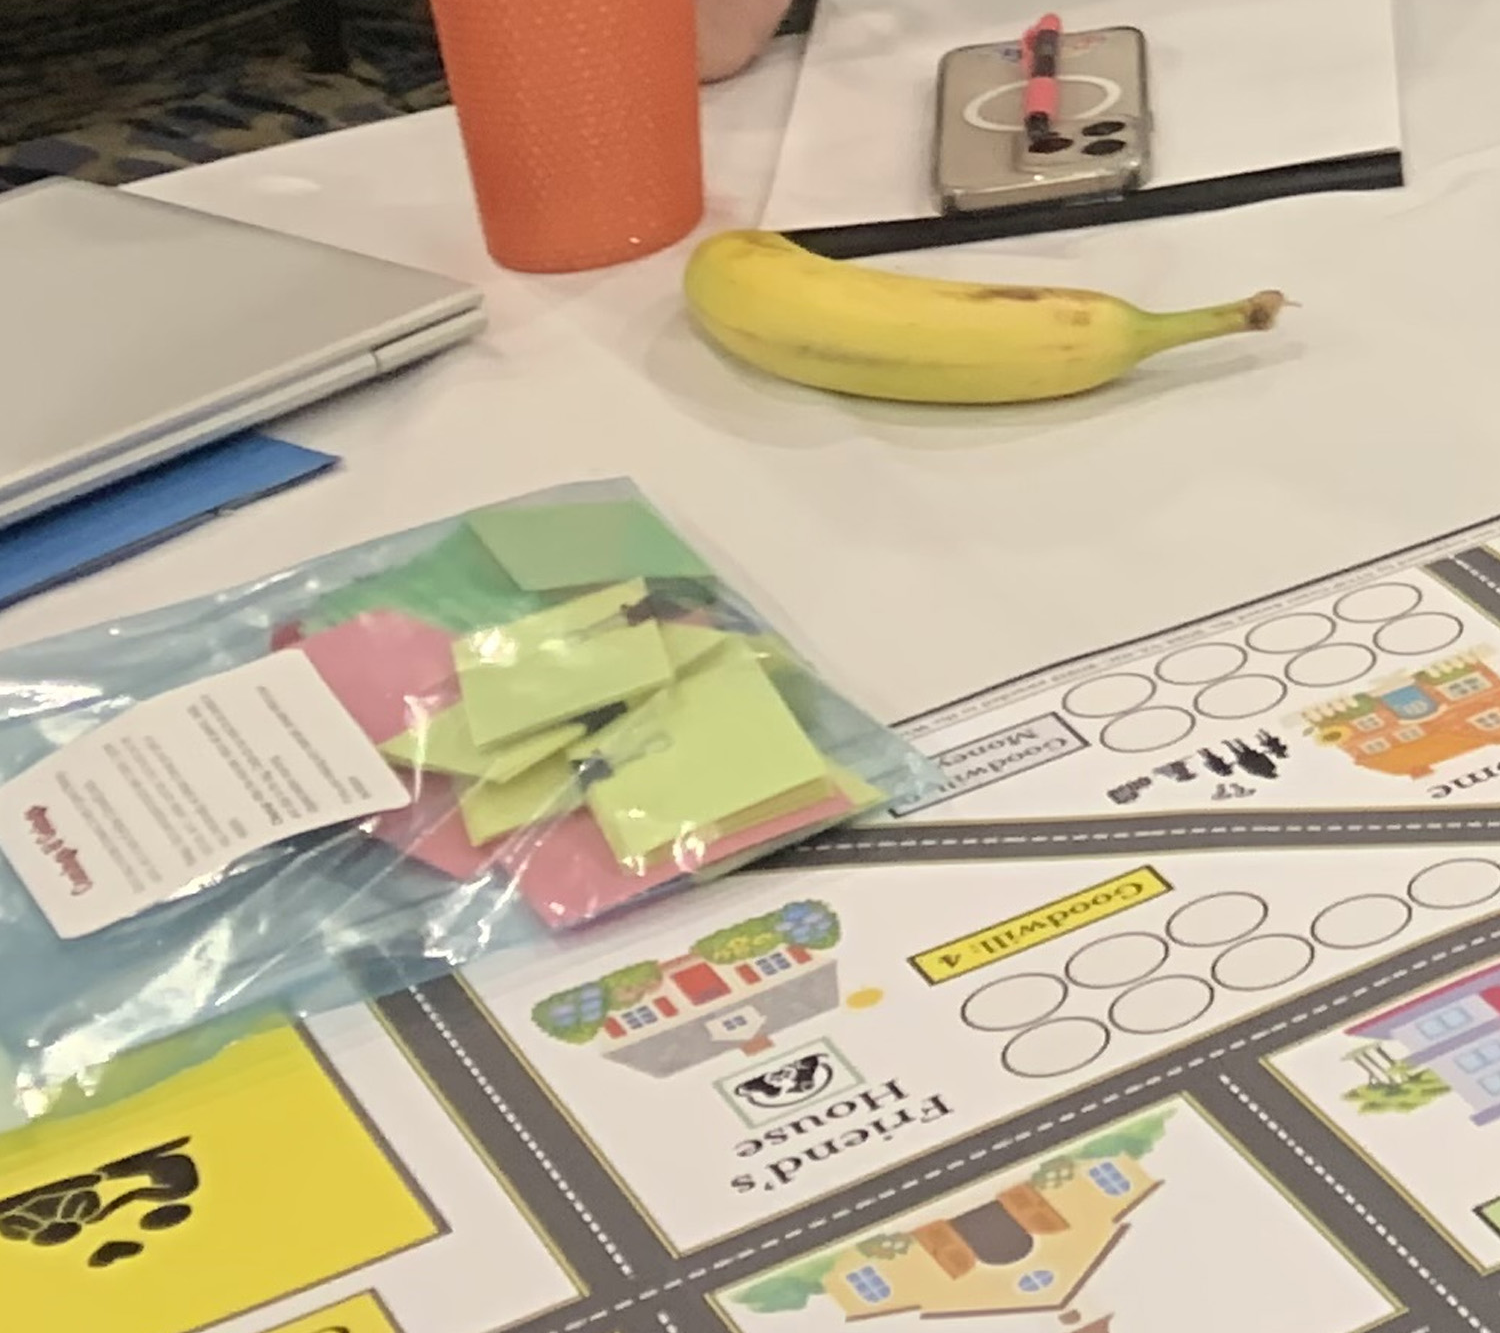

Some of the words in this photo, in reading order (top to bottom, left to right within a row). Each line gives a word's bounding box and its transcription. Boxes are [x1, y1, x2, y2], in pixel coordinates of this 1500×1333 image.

[939, 728, 1038, 768] Money
[969, 881, 1146, 956] Goodwill:
[937, 952, 964, 970] 4
[730, 1094, 955, 1193] Friend's
[734, 1079, 909, 1157] House
